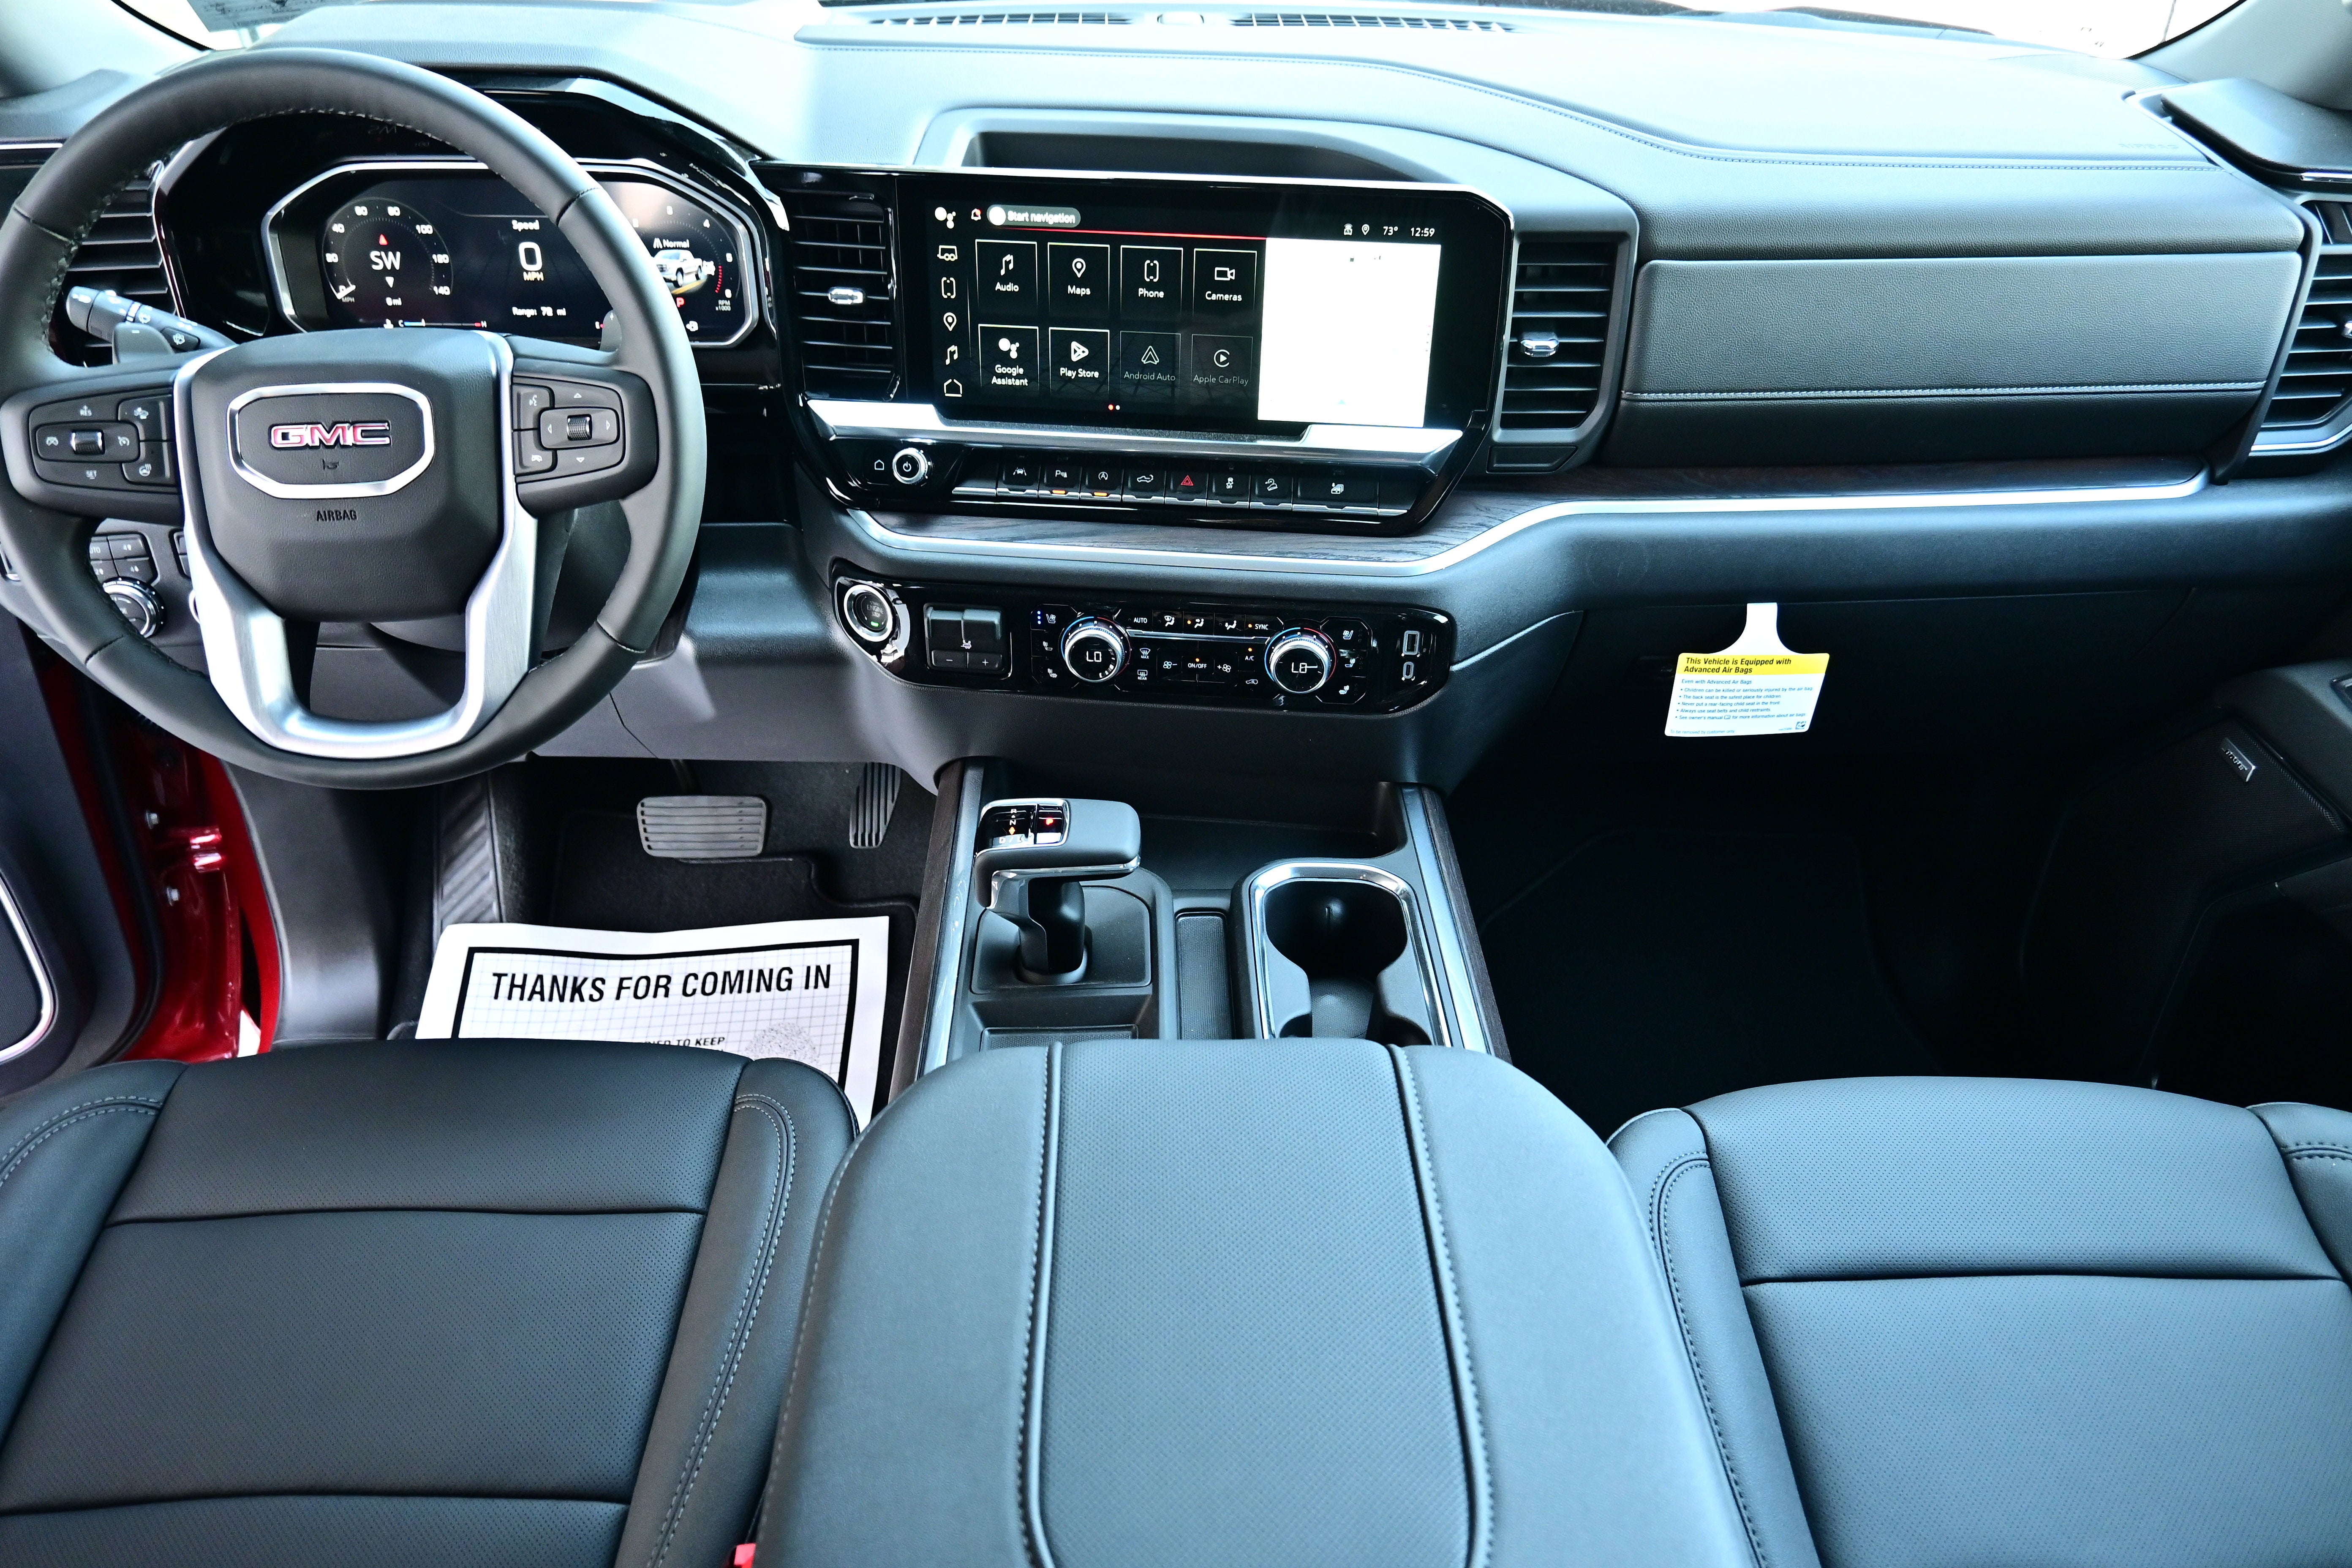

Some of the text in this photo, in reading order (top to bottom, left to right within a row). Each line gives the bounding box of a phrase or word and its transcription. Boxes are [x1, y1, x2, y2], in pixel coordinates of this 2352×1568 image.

[1007, 211, 1075, 225] Start navigation
[332, 223, 345, 233] 40
[416, 225, 433, 234] 100
[512, 219, 539, 232] Speed
[1383, 225, 1435, 237] 73° 12:59
[662, 239, 690, 248] Normal
[370, 250, 400, 270] SW
[432, 254, 449, 263] 120
[519, 241, 542, 271] 0
[523, 271, 544, 281] MPH
[433, 286, 450, 295] 140
[995, 282, 1019, 292] Audio
[1067, 285, 1091, 297] Maps
[1138, 288, 1165, 298] Phone
[1205, 291, 1242, 302] Cameras
[676, 297, 685, 308] P
[556, 308, 566, 316] mi
[995, 365, 1024, 375] Google
[1060, 367, 1099, 378] Play Store
[991, 376, 1028, 386] Assistant
[1124, 371, 1176, 381] Android Auto
[1193, 374, 1249, 387] Apple CarPlay
[271, 422, 391, 448] GMC
[316, 509, 357, 522] AIRBAG
[866, 604, 884, 615] ENGINE
[1045, 817, 1054, 825] P
[493, 964, 831, 1002] THANKS FOR COMING IN
[695, 1037, 725, 1046] KEEP
